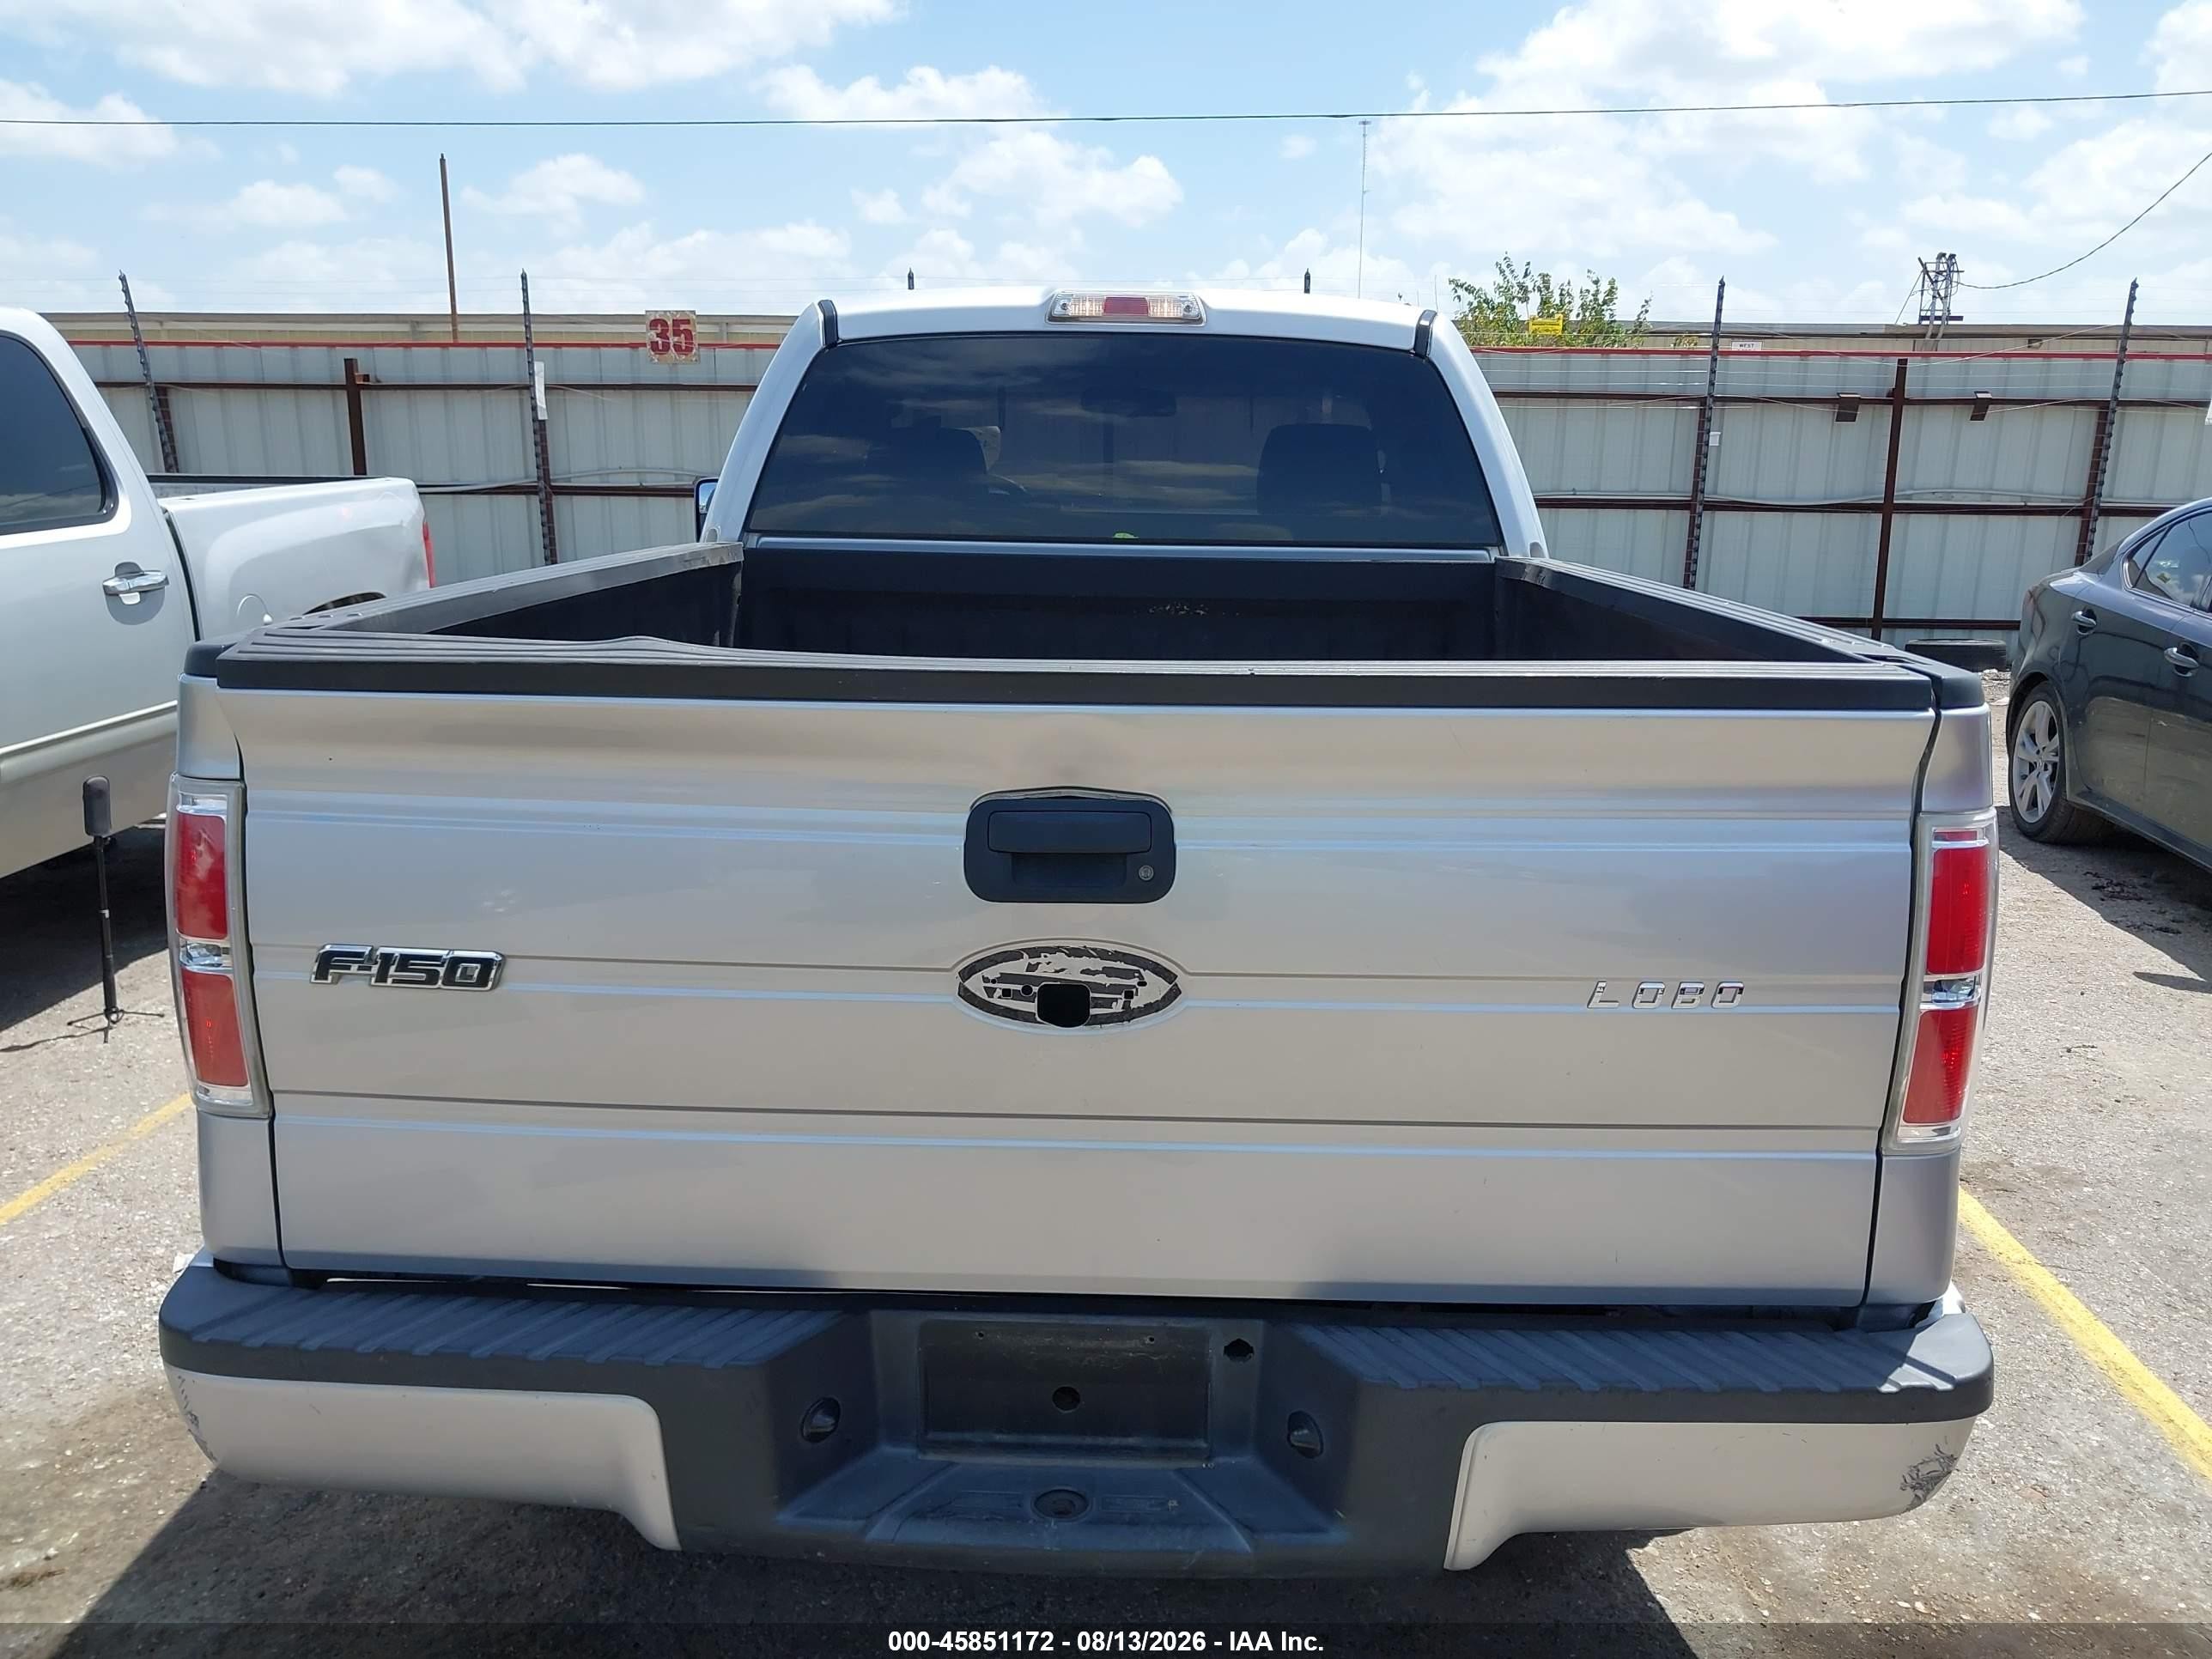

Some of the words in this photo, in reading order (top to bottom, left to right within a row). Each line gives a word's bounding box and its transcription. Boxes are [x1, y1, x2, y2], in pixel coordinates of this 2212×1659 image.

[649, 318, 695, 356] 35
[310, 944, 505, 991] F-150
[1587, 981, 1745, 1010] LOBO
